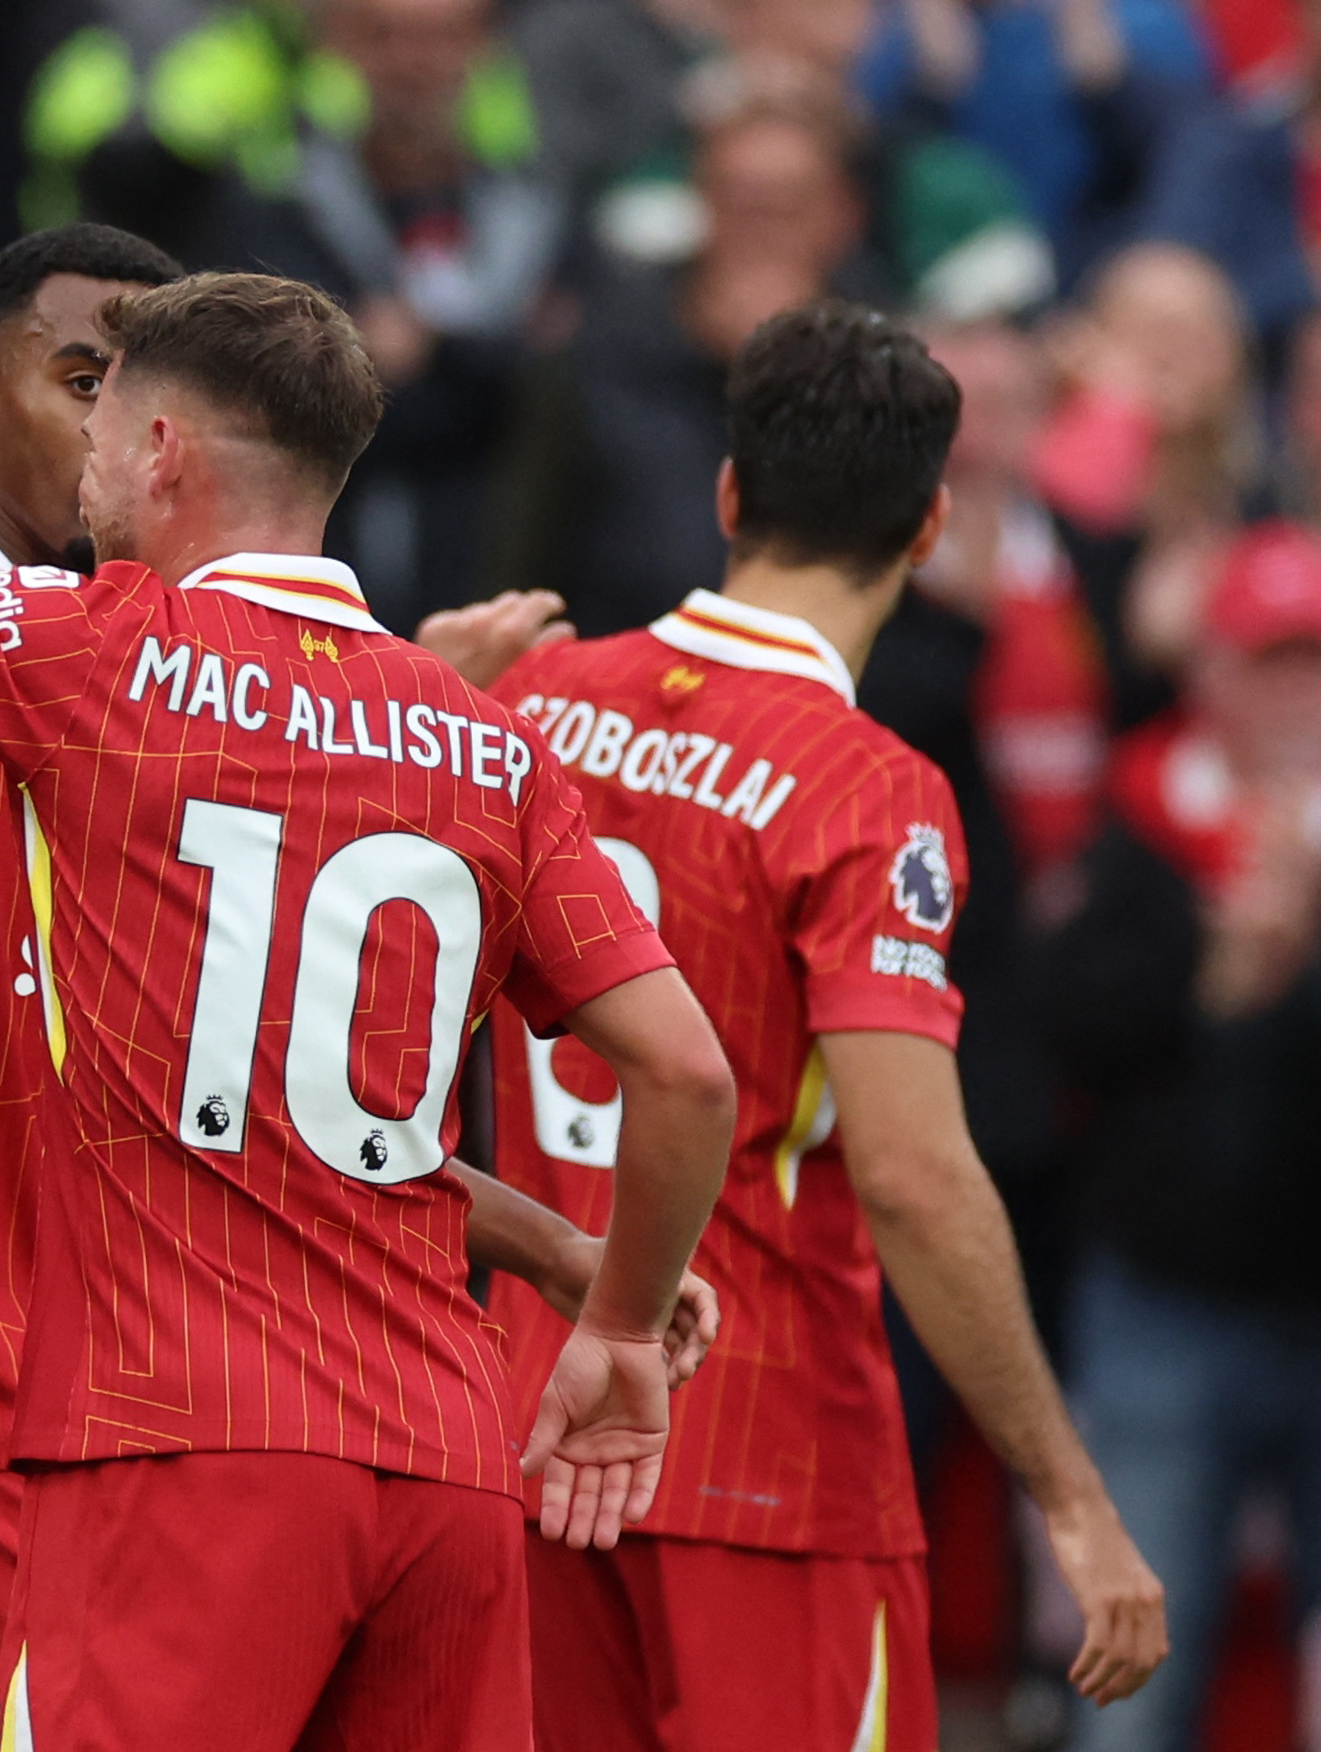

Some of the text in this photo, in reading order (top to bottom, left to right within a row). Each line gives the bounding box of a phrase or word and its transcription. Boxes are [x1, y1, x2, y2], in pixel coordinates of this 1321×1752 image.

[127, 635, 532, 808] MAC ALLISTER
[176, 797, 483, 1186] 10
